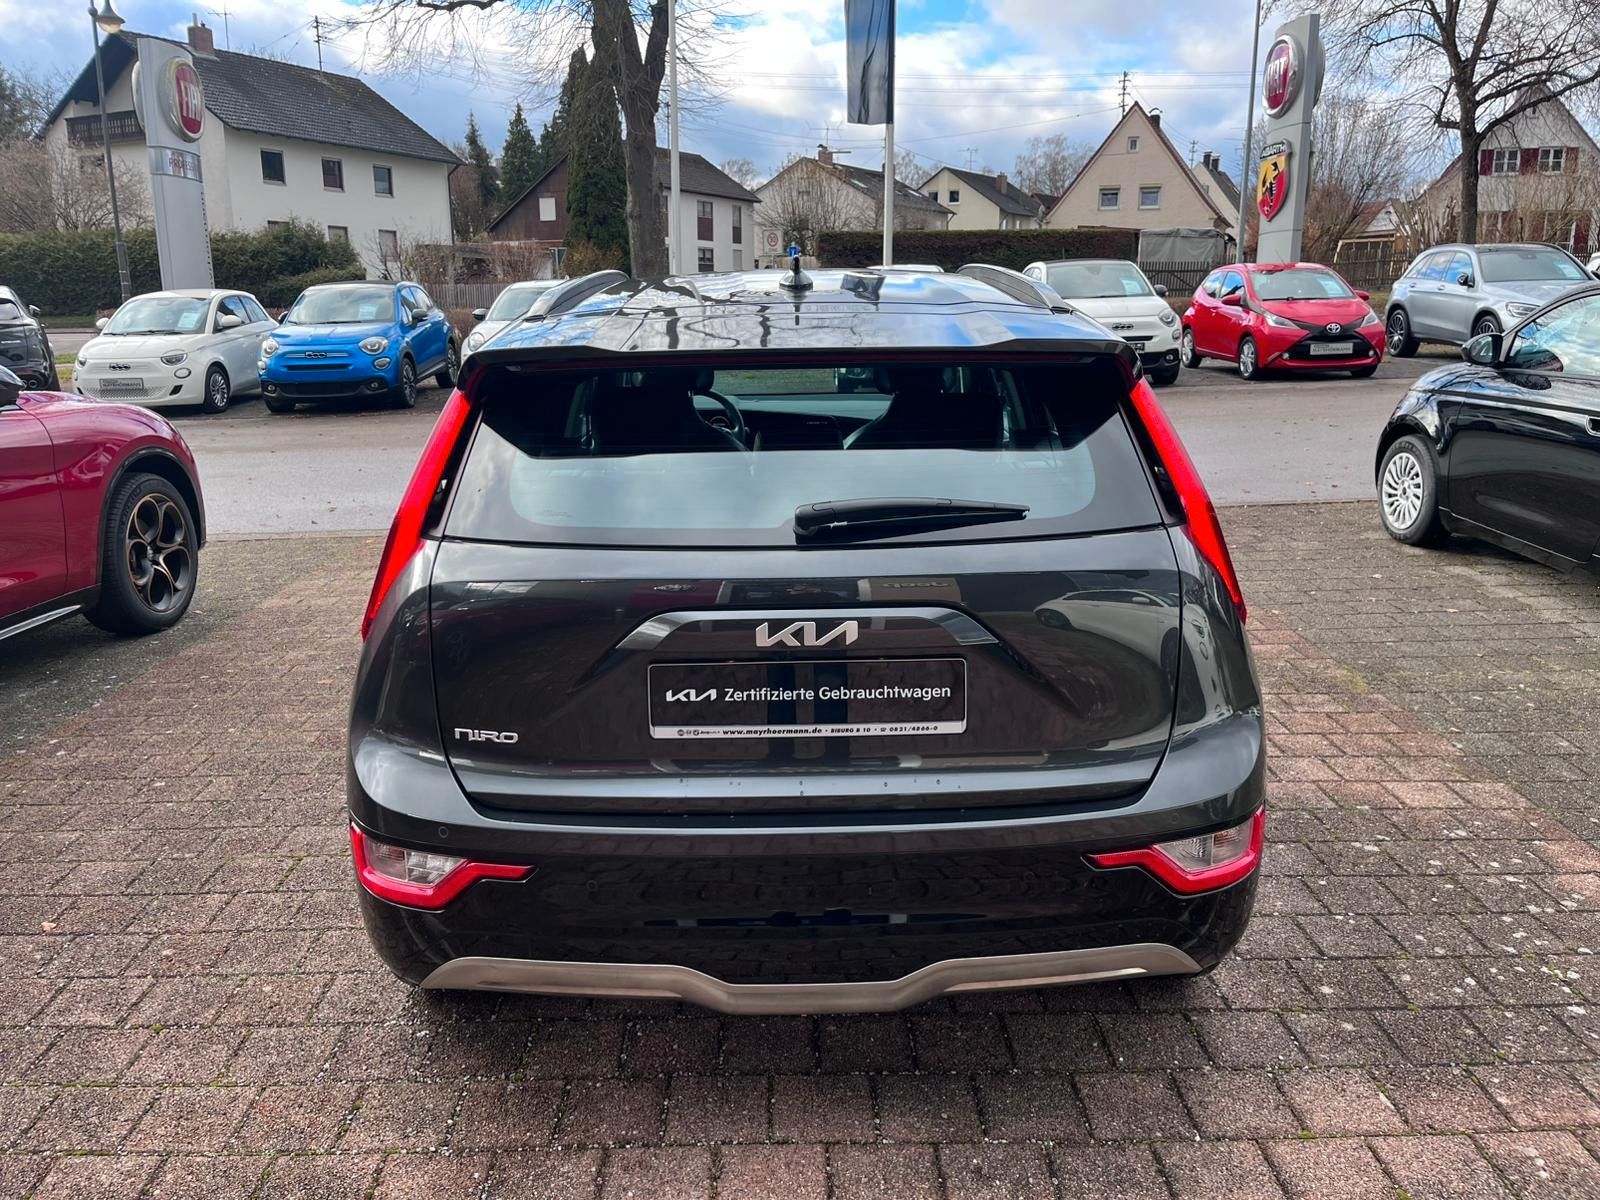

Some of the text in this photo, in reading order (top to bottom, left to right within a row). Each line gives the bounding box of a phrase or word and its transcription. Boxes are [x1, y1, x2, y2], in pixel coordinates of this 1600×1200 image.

[1262, 143, 1287, 157] ABARTH
[756, 620, 858, 647] KIA
[665, 685, 951, 702] KIA Zertifizierte Gebrauchtwagen
[454, 727, 519, 743] NIRO
[723, 727, 822, 736] www.mayrhoermann.de
